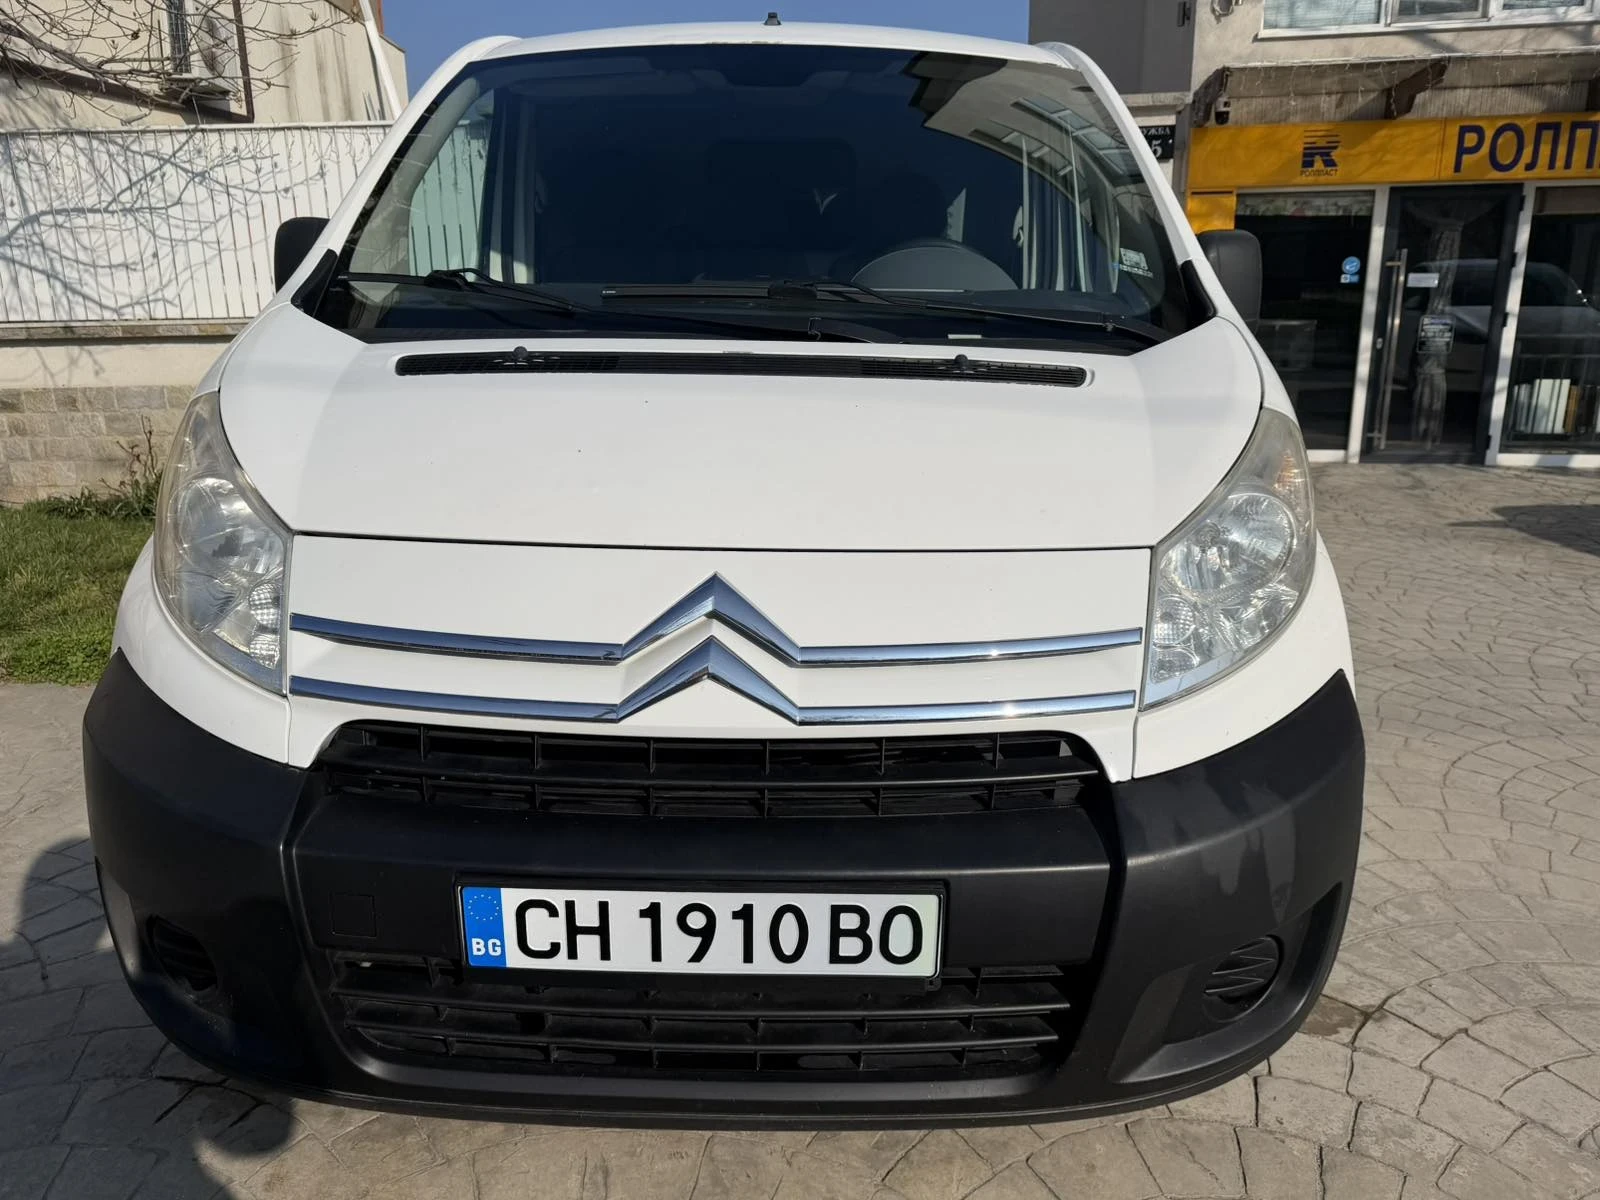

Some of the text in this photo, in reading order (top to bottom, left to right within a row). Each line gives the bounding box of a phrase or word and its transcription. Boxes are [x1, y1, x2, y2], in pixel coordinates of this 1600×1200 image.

[1453, 120, 1600, 173] РОЛП
[471, 938, 502, 957] BG
[515, 898, 924, 965] CH 1910 BO
